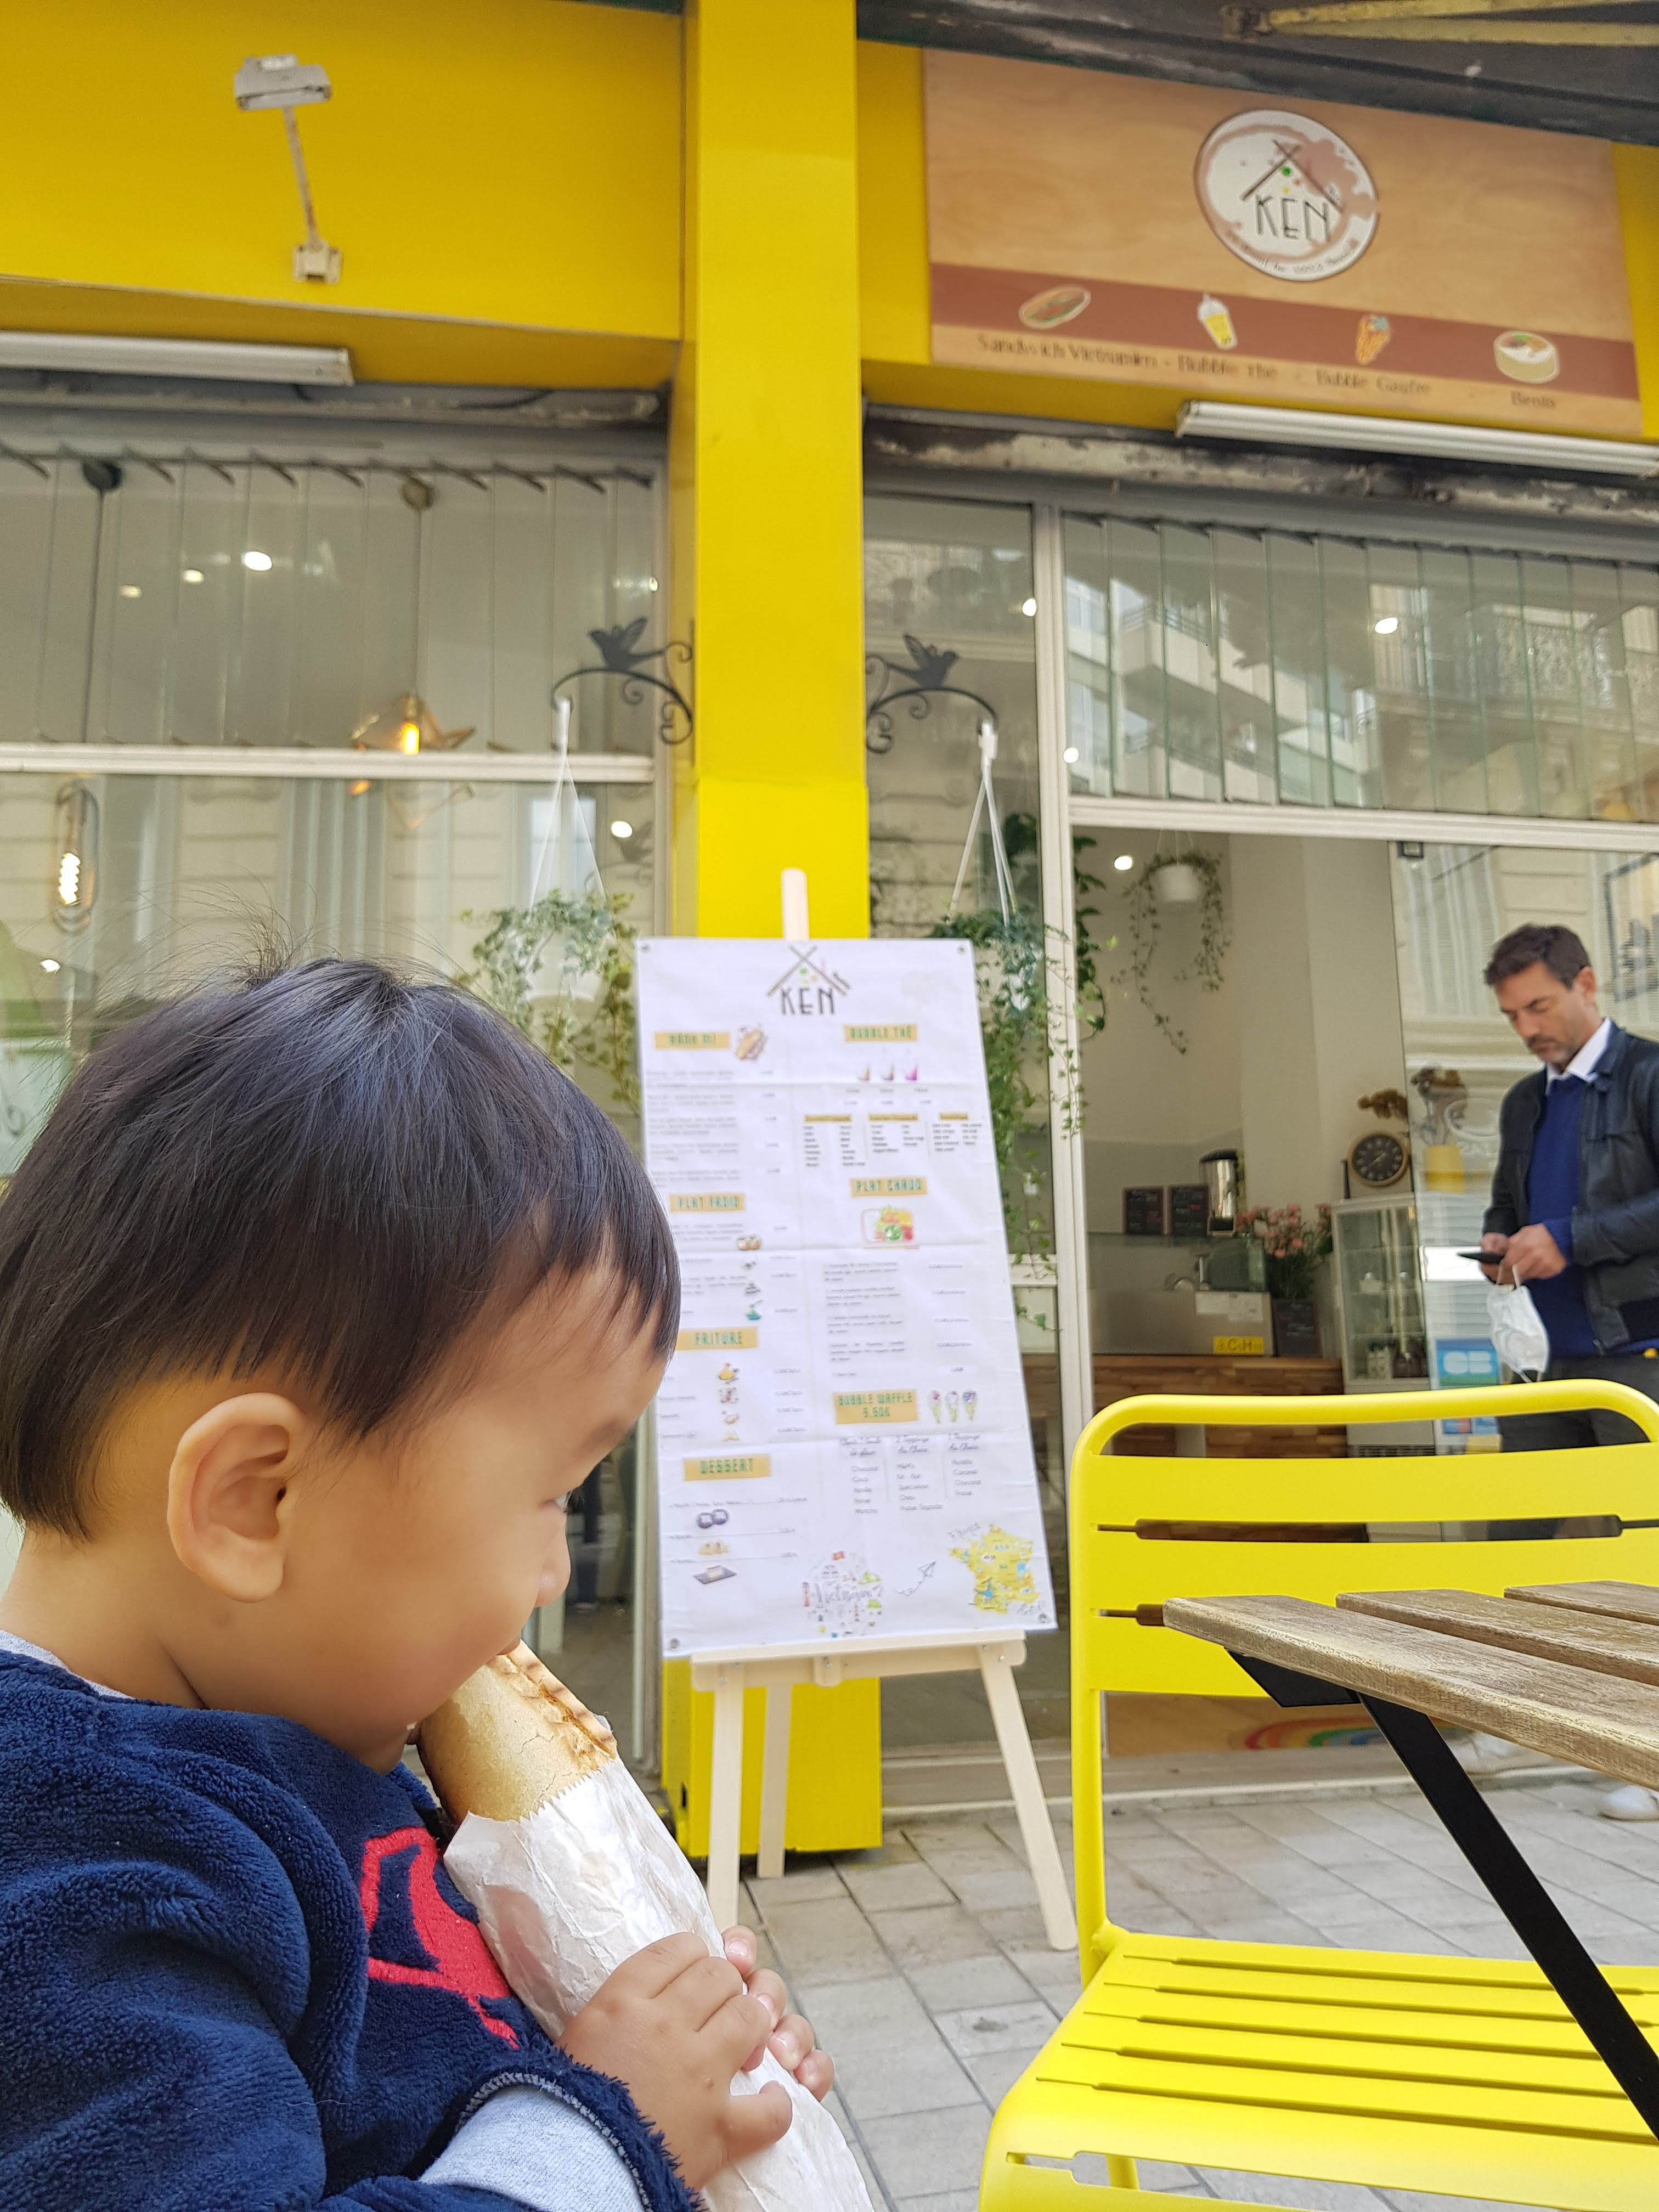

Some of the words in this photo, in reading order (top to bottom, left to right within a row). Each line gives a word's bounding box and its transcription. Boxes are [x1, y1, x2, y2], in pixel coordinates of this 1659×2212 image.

[1255, 194, 1330, 241] KEN
[780, 986, 835, 1016] KEN
[693, 1331, 742, 1346] FRITURE
[838, 1393, 873, 1406] BUBBLE
[877, 1392, 913, 1404] WAFFLE
[699, 1457, 754, 1475] DESSERT
